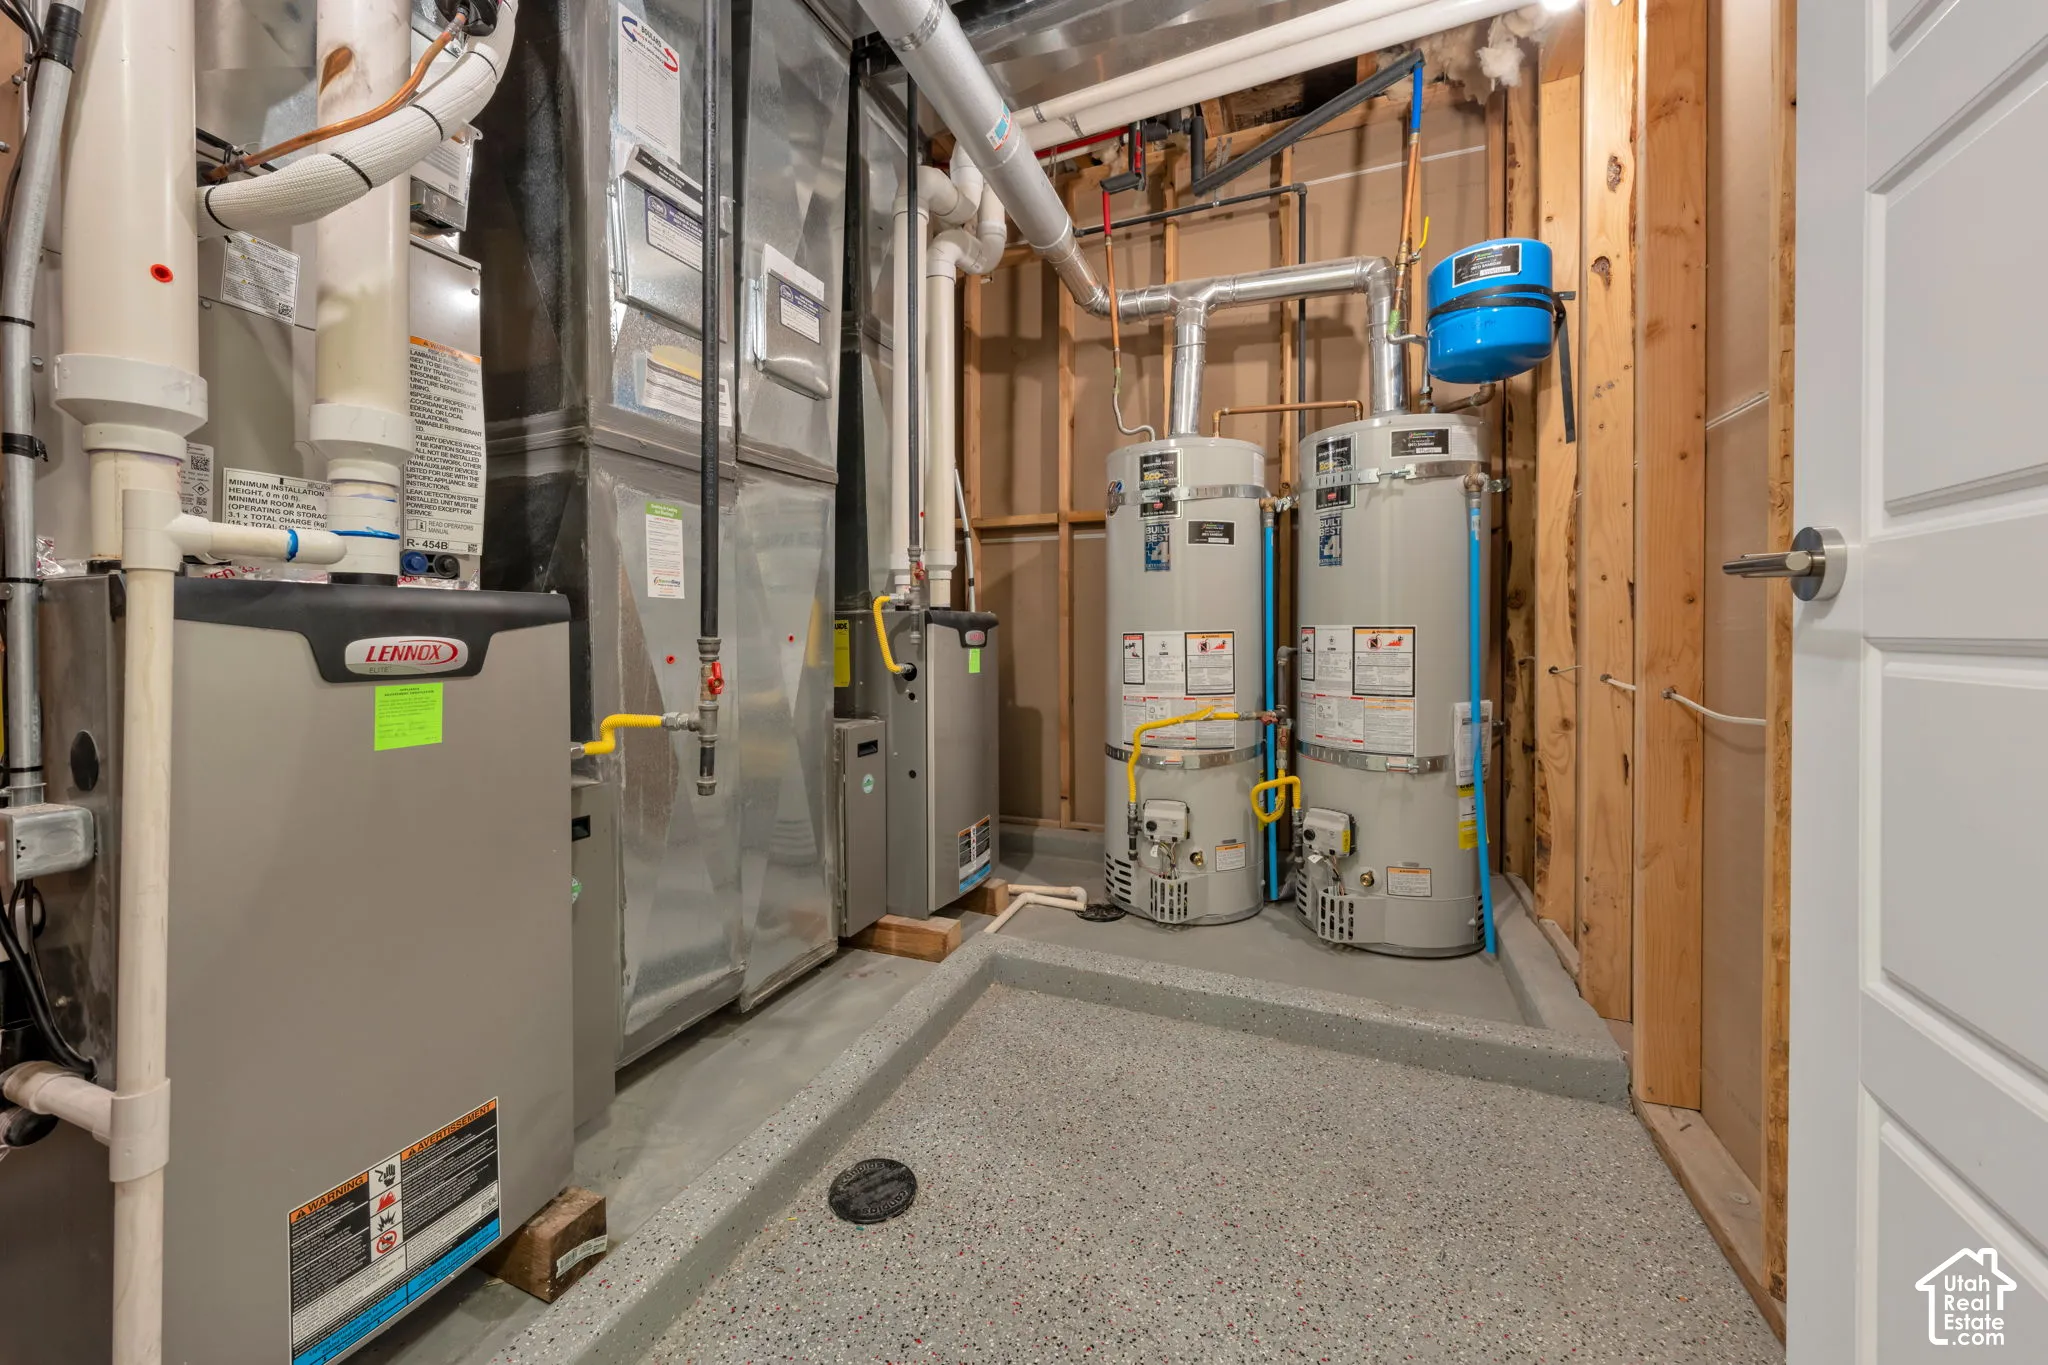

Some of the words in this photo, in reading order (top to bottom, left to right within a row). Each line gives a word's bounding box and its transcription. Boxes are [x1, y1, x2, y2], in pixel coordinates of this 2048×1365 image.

[410, 349, 442, 362] LAMMABLE
[410, 377, 439, 389] UNCTURE
[410, 383, 430, 392] UBING.
[410, 398, 448, 411] CCORDANCE
[410, 405, 435, 414] EDERAL
[228, 479, 269, 489] MINIMUM
[271, 485, 325, 497] INSTALLATION
[424, 490, 456, 500] DETECTION
[228, 495, 268, 505] MINIMUM
[270, 499, 294, 508] ROOM
[296, 503, 317, 511] AREA
[406, 502, 437, 510] POWERED
[438, 505, 460, 514] EXCEPT
[228, 503, 281, 515] (OPERATING
[296, 511, 328, 519] STORAG
[251, 513, 277, 522] TOTAL
[279, 516, 312, 526] CHARGE
[1320, 518, 1341, 527] BUILT
[1146, 525, 1170, 534] BUILT
[1320, 526, 1341, 537] BEST
[1146, 533, 1170, 542] BEST
[422, 540, 448, 550] 454B
[365, 644, 442, 662] LENNOX
[417, 1103, 491, 1151] AVERTISSEMENT
[308, 1176, 364, 1213] WARNING
